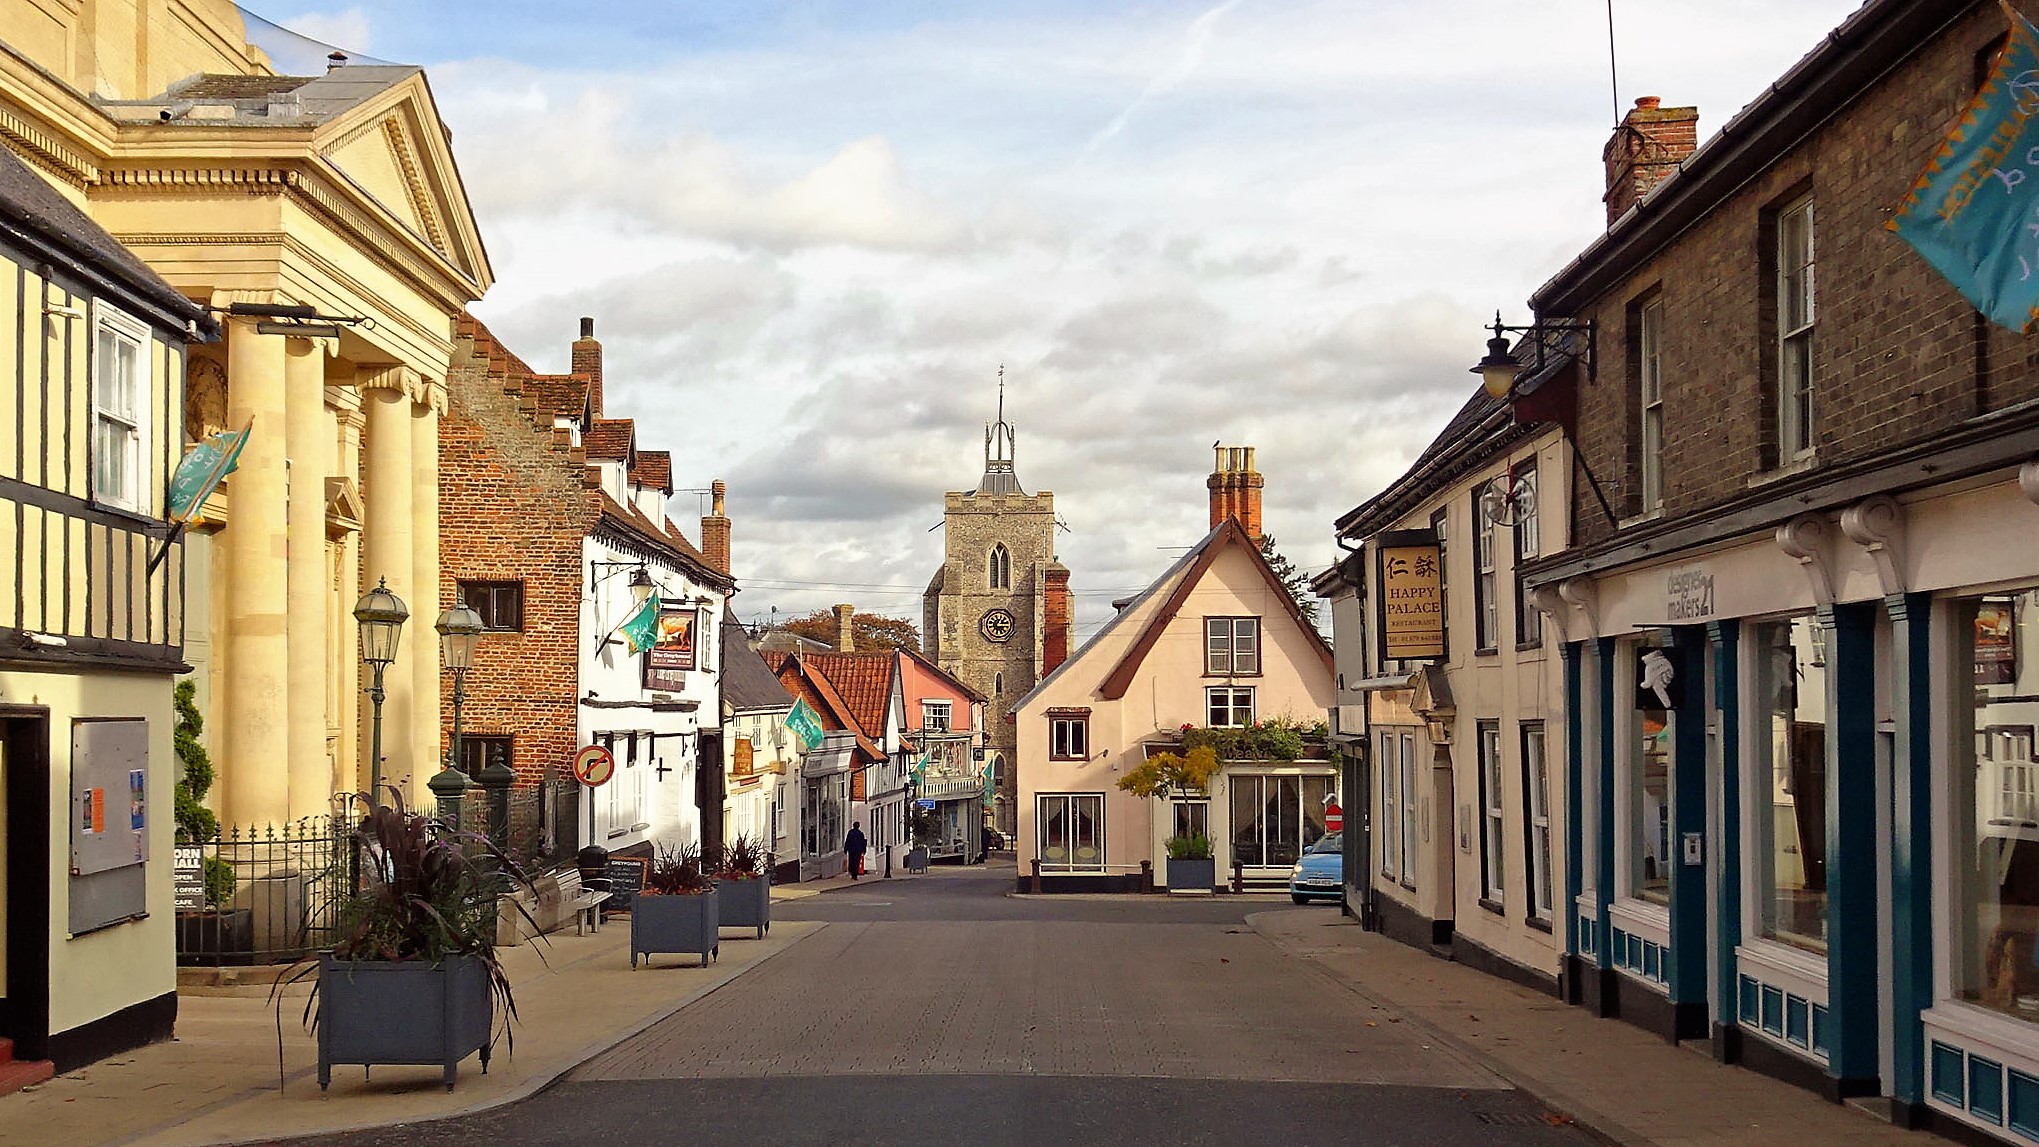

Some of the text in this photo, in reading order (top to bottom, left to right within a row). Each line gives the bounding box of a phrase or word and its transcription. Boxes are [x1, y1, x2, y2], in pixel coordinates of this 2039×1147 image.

[1390, 587, 1435, 598] HAPPY
[1387, 602, 1440, 614] PALACE
[174, 848, 201, 859] ORN
